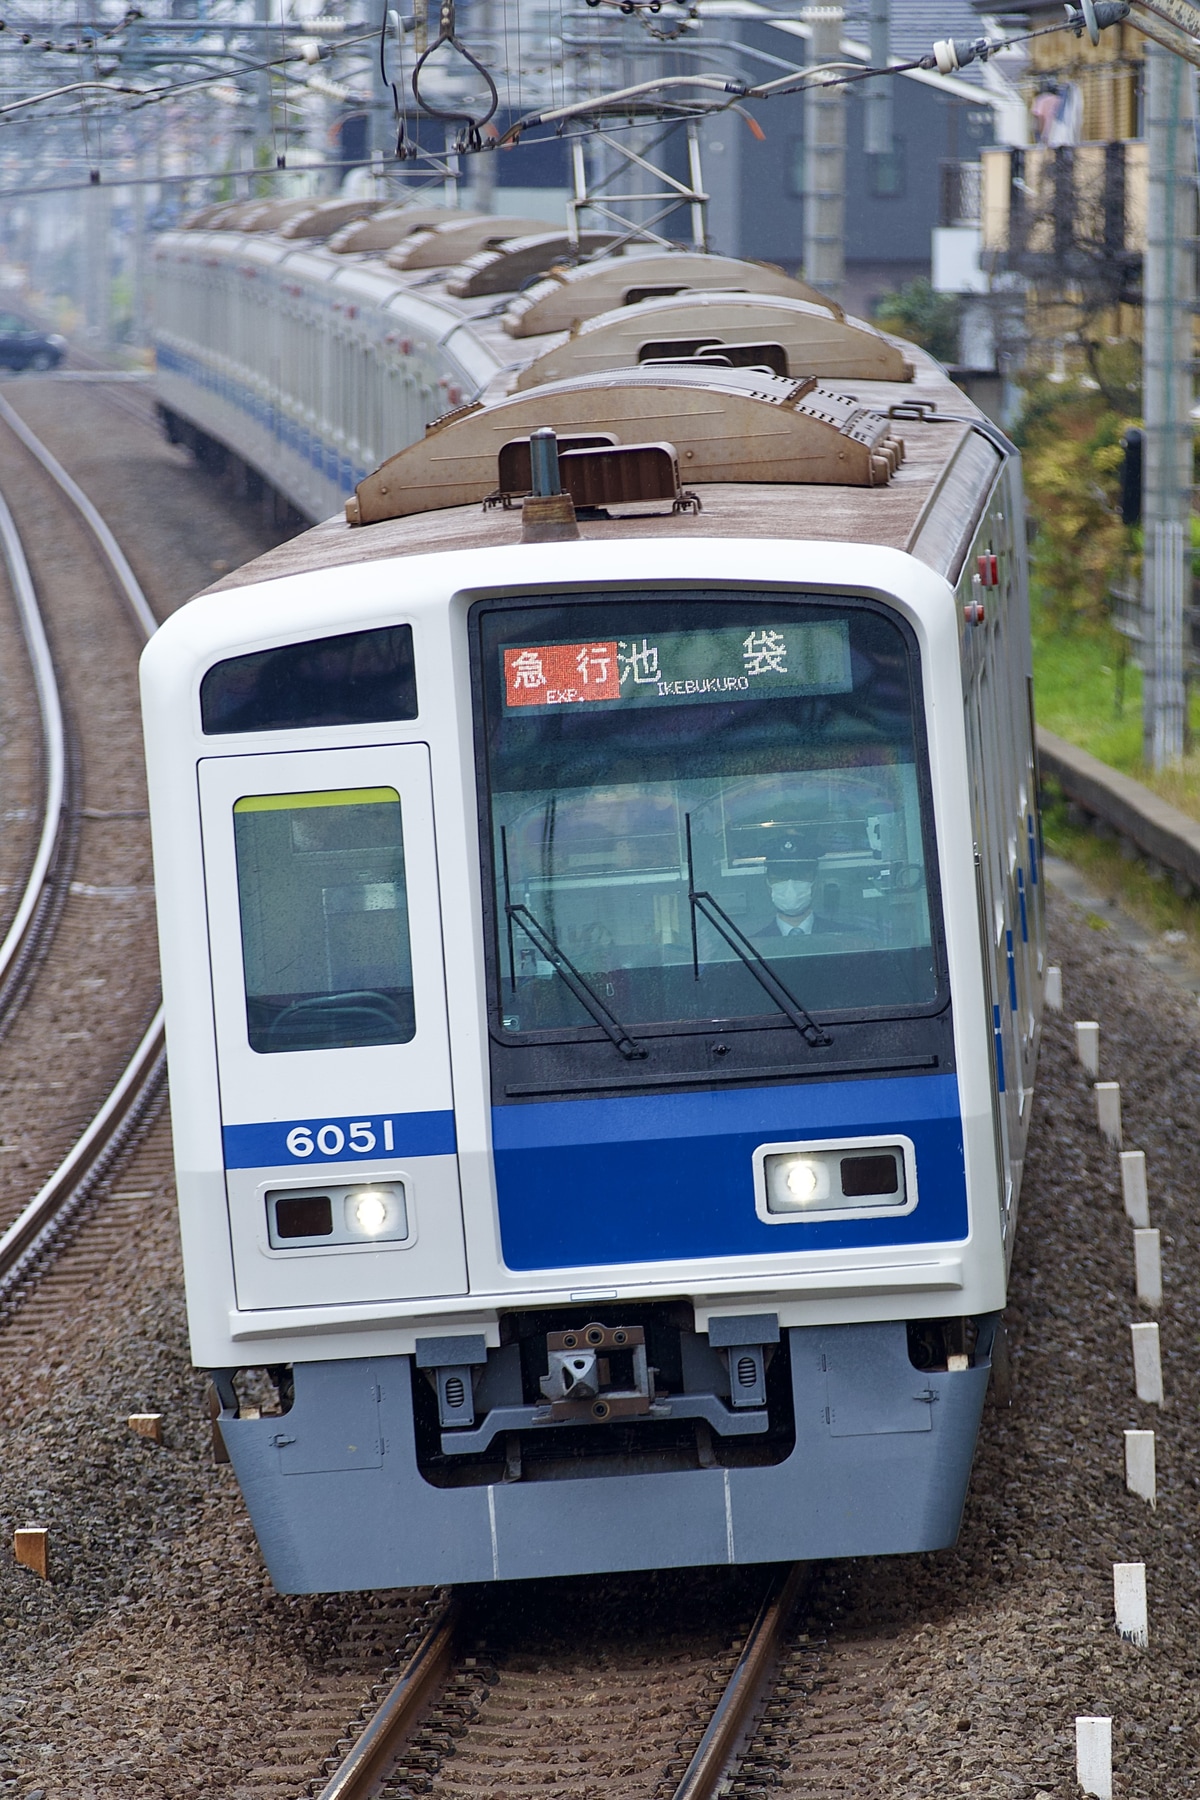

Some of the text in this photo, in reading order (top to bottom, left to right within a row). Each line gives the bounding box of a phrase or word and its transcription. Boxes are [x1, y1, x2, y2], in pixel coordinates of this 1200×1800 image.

[511, 647, 611, 689] 急行
[617, 630, 788, 685] 池袋
[546, 689, 585, 705] EXP.
[657, 676, 750, 697] IKEBUKURO
[286, 1119, 395, 1158] 6051
